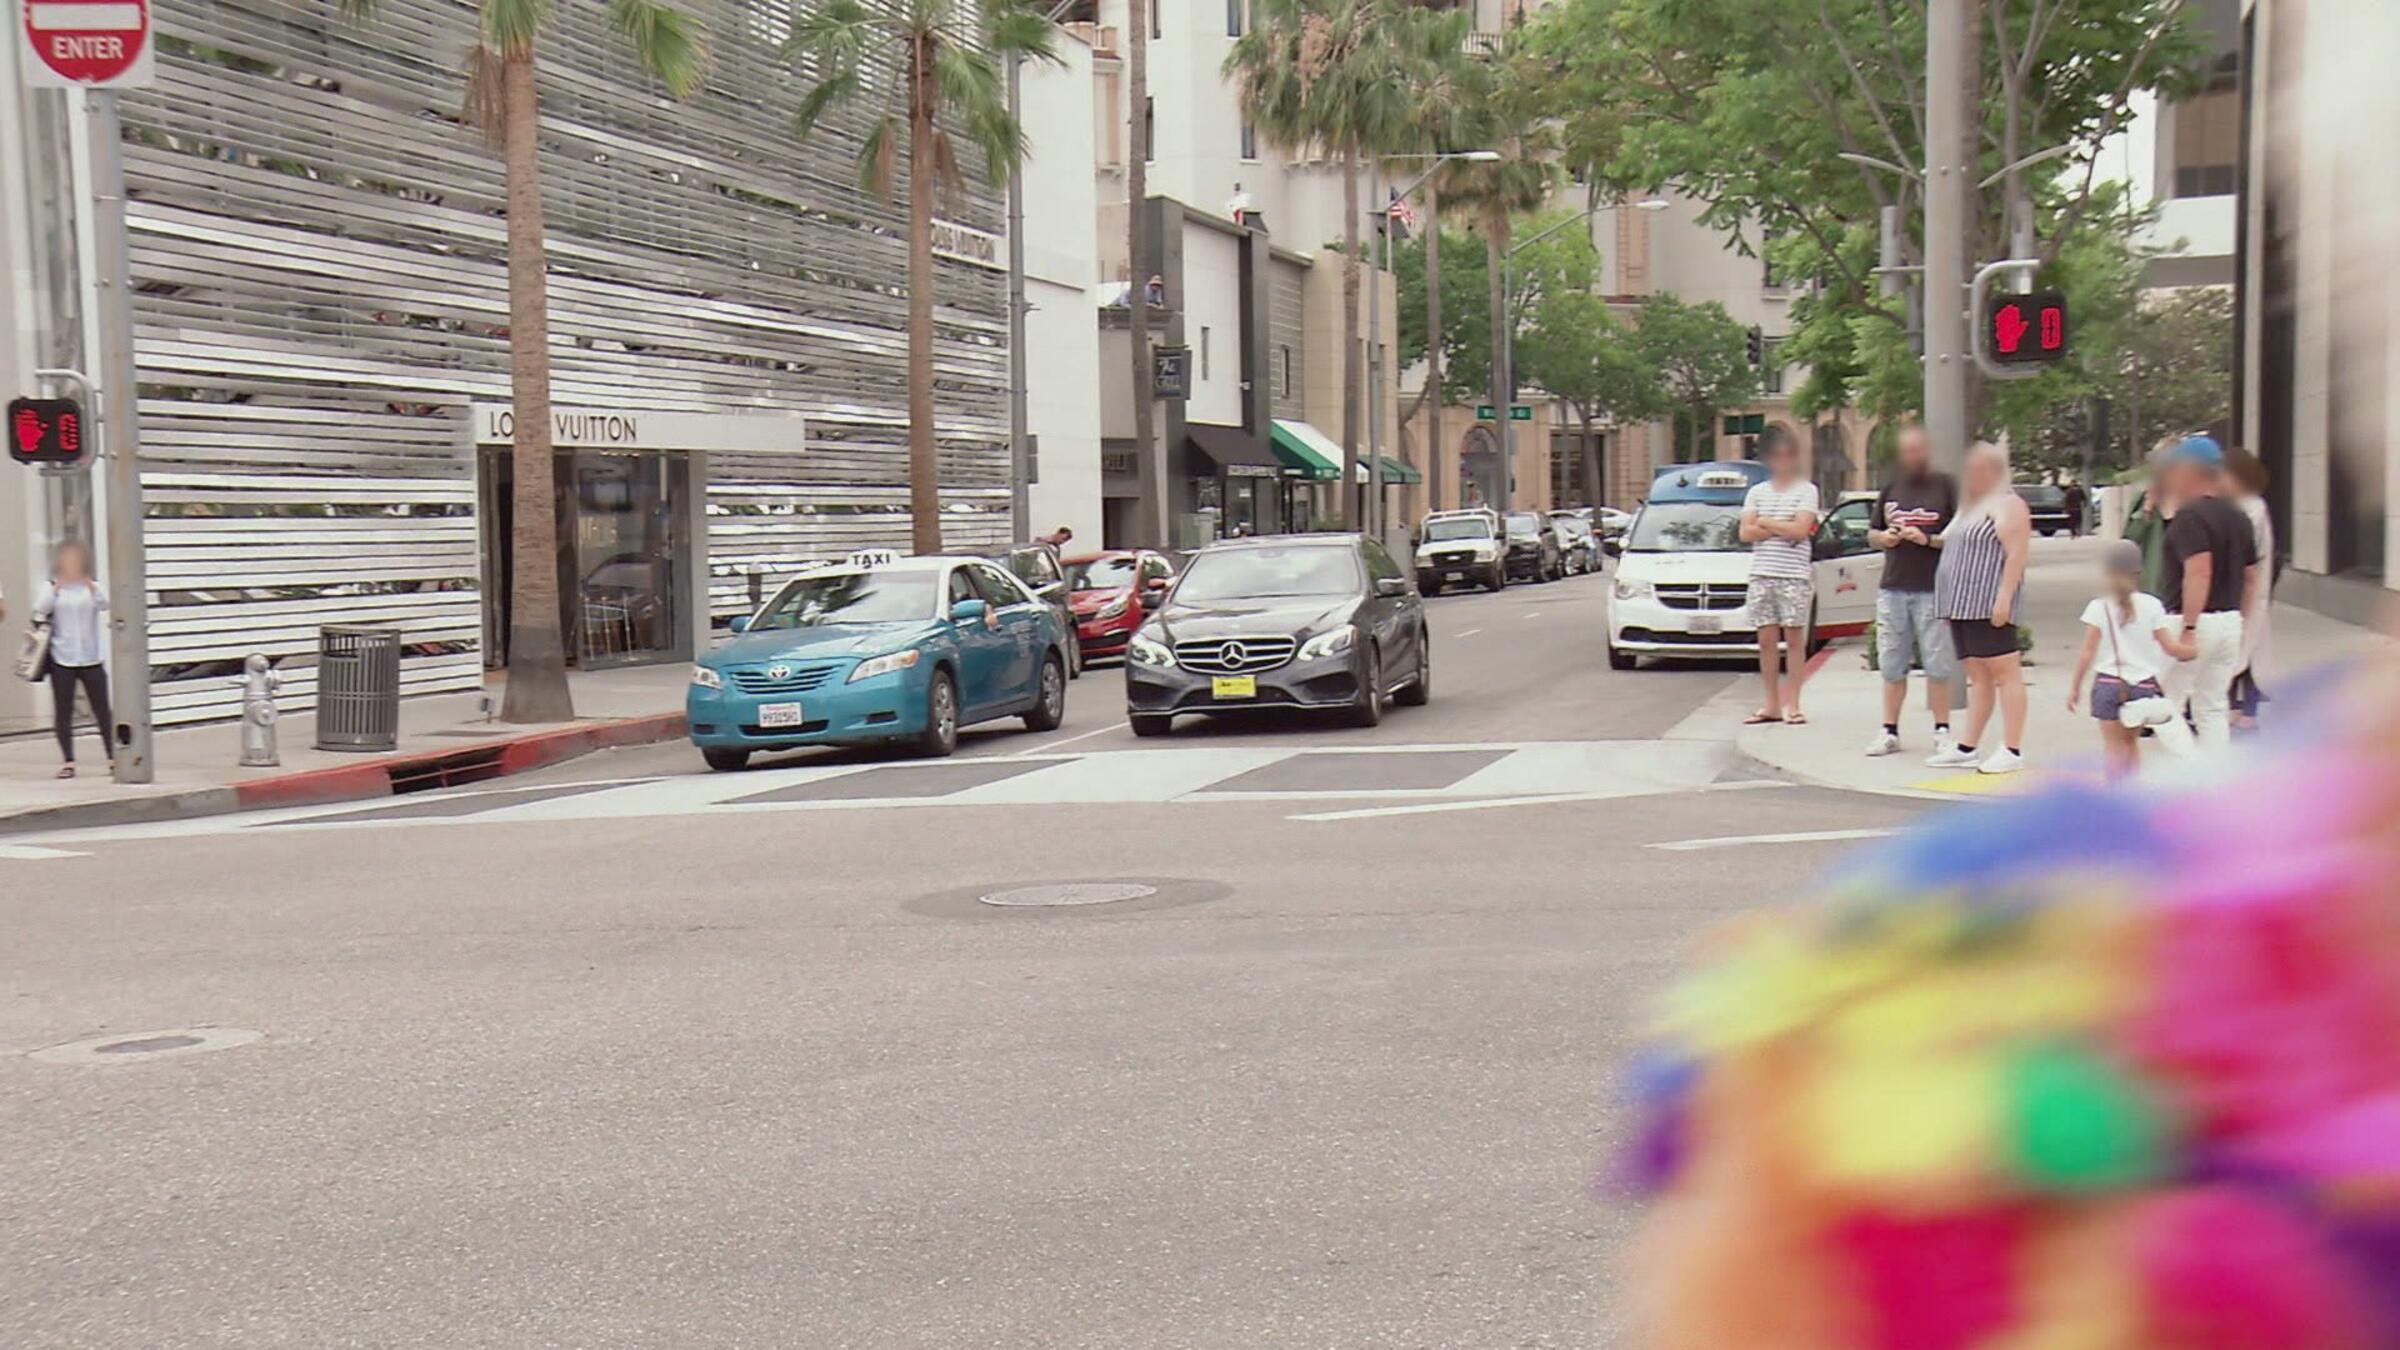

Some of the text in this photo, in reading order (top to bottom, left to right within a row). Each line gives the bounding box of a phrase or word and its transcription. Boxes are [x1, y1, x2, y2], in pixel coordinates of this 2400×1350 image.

[53, 36, 123, 59] ENTER
[2041, 308, 2061, 349] 0
[555, 414, 637, 441] VUITTON
[852, 553, 890, 567] TAXI
